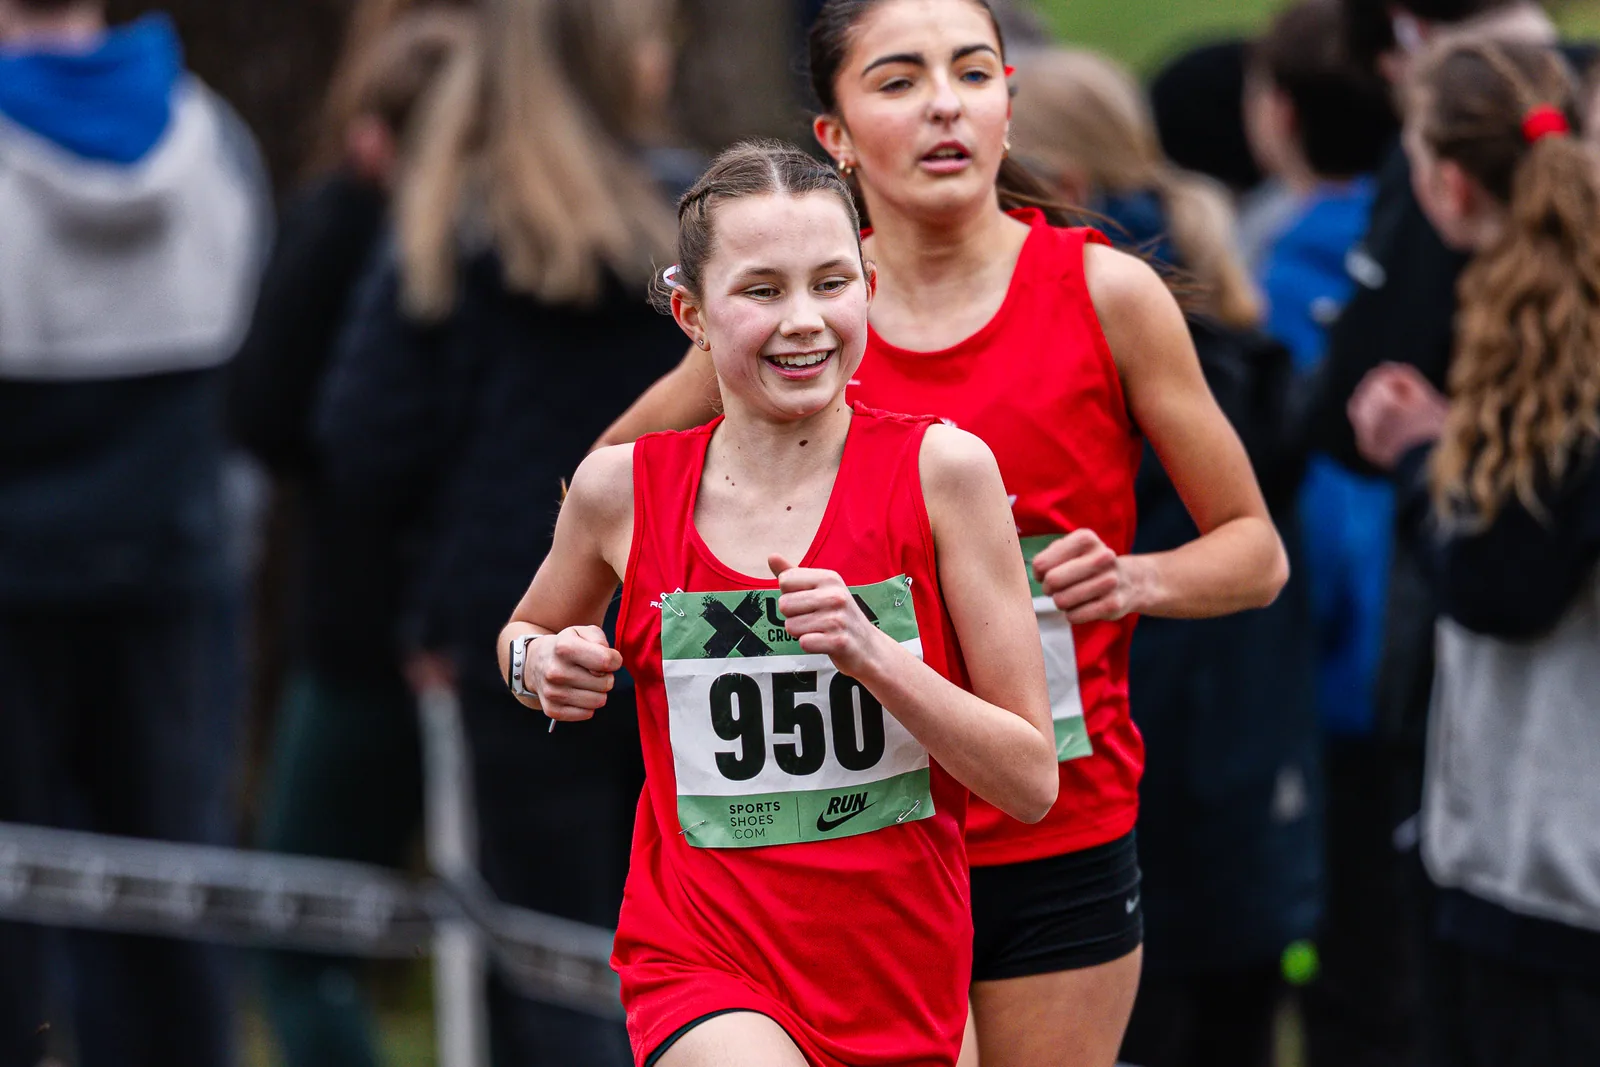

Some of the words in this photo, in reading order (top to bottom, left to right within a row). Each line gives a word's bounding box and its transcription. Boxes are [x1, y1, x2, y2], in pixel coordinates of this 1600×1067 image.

[709, 671, 886, 782] 950
[729, 801, 781, 814] SPORTS
[827, 792, 868, 815] RUN
[730, 815, 774, 827] SHOES
[732, 828, 765, 839] .COM
